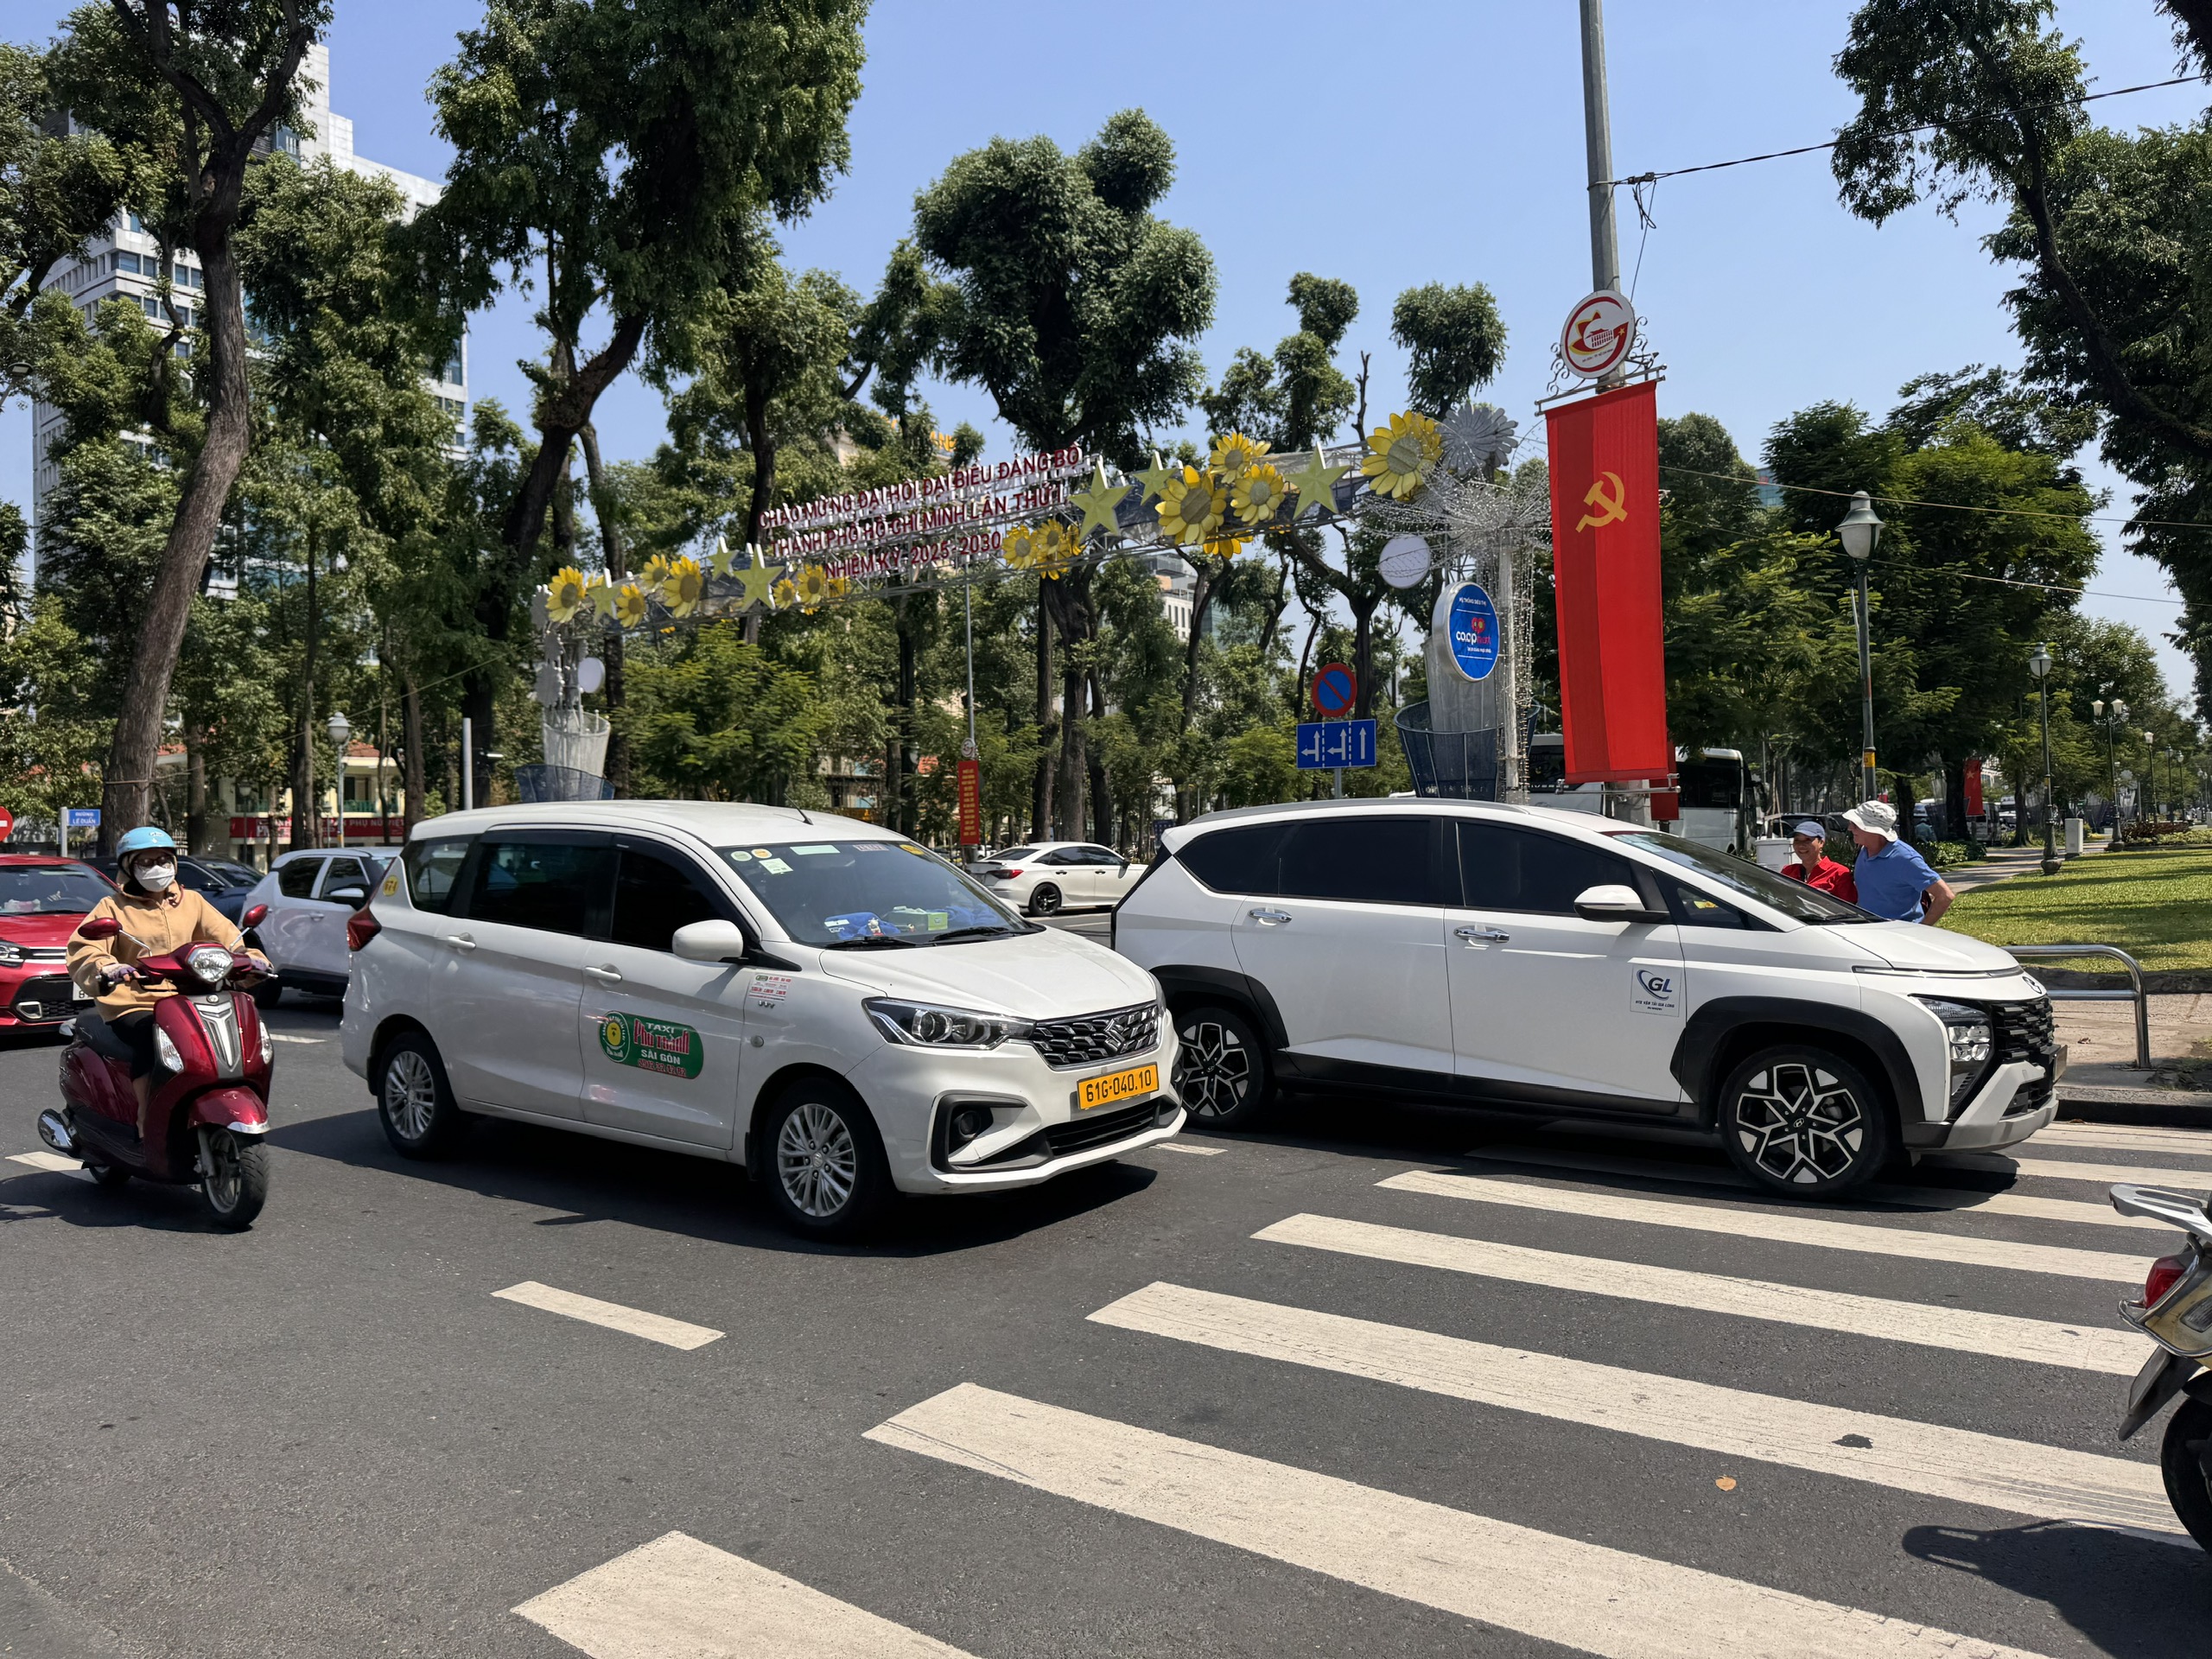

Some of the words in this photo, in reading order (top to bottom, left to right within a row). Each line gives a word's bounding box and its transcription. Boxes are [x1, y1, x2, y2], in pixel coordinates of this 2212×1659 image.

[759, 504, 801, 528] CHÀO
[804, 494, 853, 521] MỪNG
[858, 487, 885, 510] ĐẠI
[923, 474, 950, 498] ĐẠI
[999, 453, 1049, 480] ĐẢNG
[1054, 443, 1080, 469] BỘ
[771, 531, 823, 556] THÀNH
[826, 520, 860, 548] PHỐ
[864, 515, 887, 539] HỒ
[891, 510, 917, 535] CHÍ
[923, 505, 966, 530] MINH
[971, 492, 1007, 519] LẦN
[1013, 482, 1052, 511] THỨ
[825, 553, 874, 579] NHIỆM
[879, 547, 901, 569] KỲ
[911, 540, 950, 564] 2025
[959, 531, 1001, 555] 2030
[1648, 977, 1673, 993] GL
[645, 1022, 675, 1034] TAXI
[640, 1049, 658, 1060] SÀI
[659, 1052, 681, 1065] GÒN
[1086, 1070, 1152, 1102] 61G-040.10
